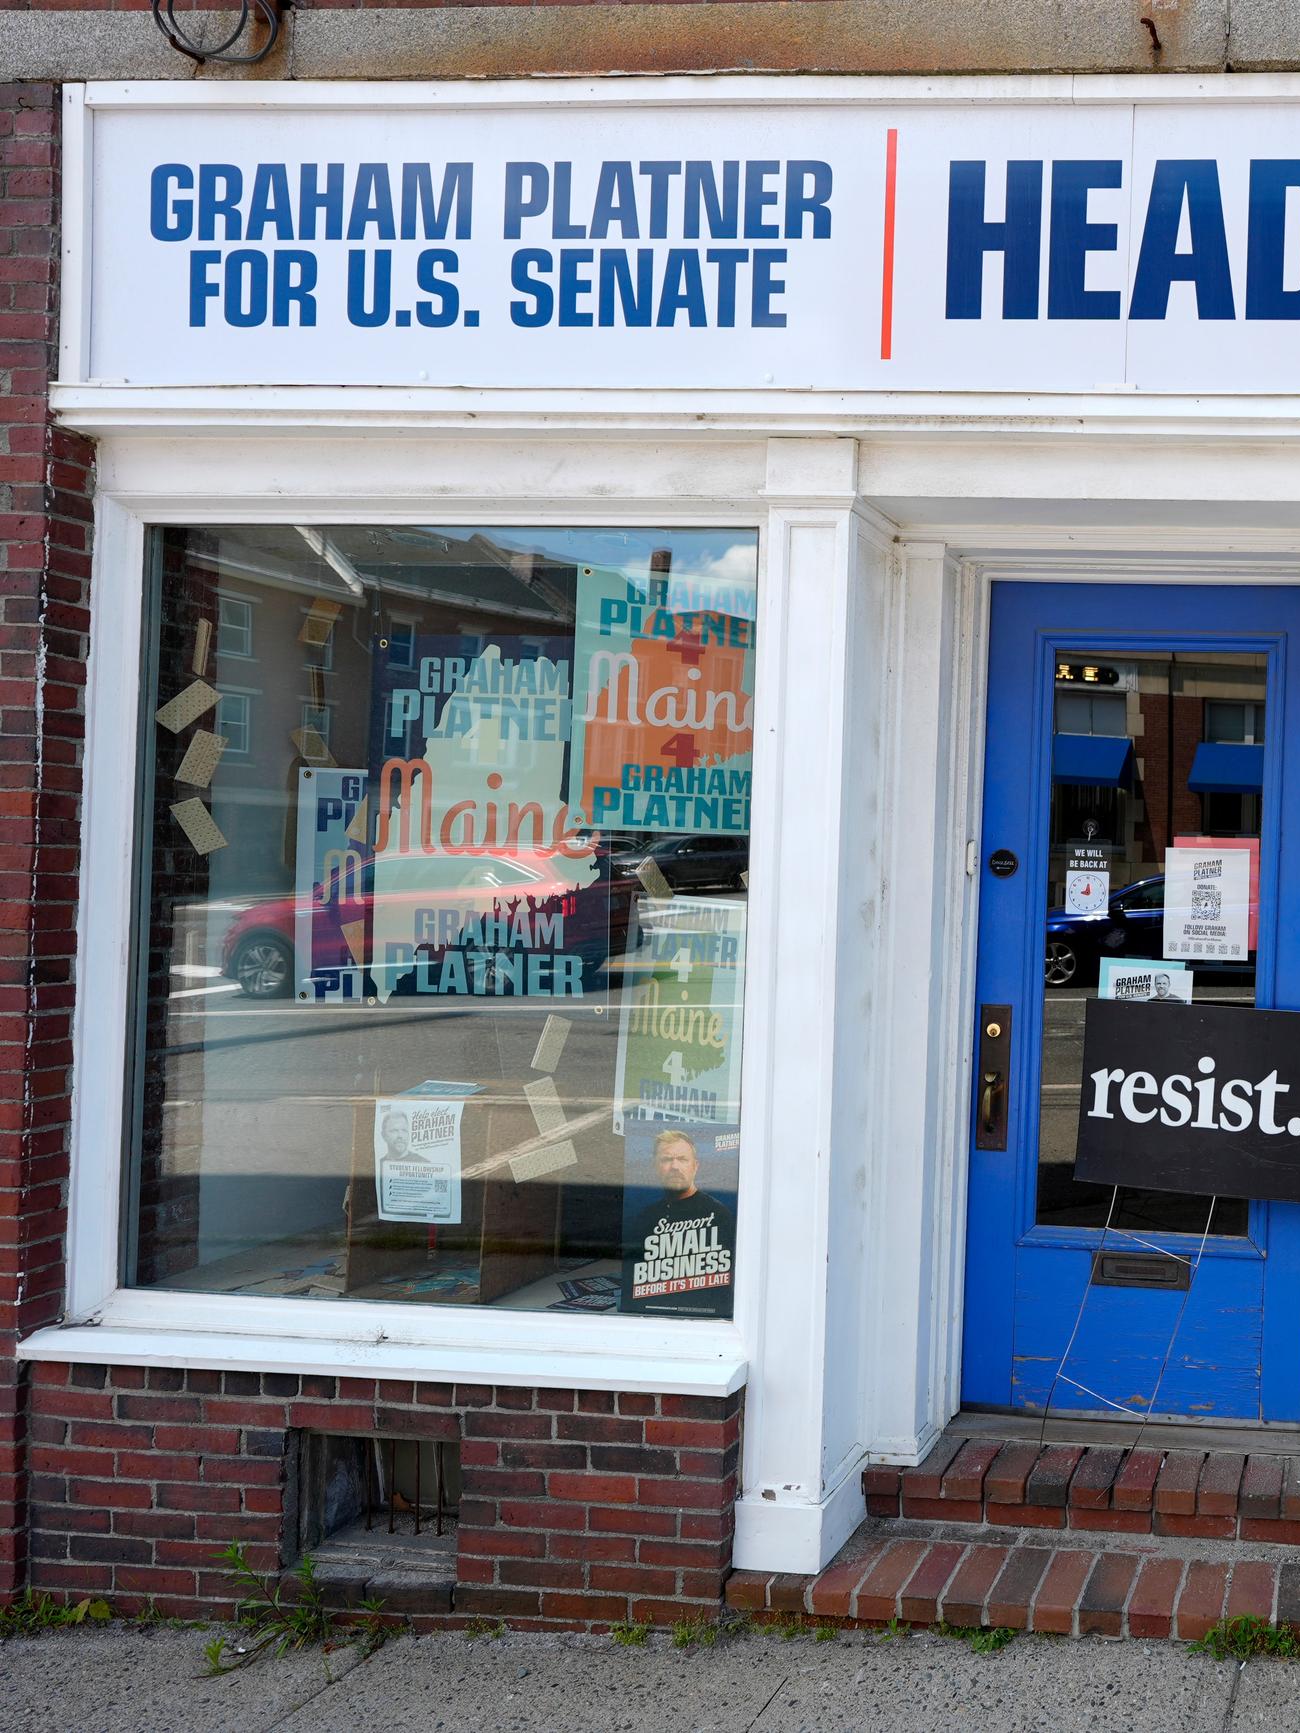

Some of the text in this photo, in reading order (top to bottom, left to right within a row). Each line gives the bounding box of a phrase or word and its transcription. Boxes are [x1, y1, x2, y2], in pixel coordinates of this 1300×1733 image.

[150, 160, 834, 242] GRAHAM PLATNER
[189, 248, 788, 329] FOR U.S. SENATE
[600, 597, 756, 650] PLATNE
[419, 656, 570, 696] GRAHAM
[660, 733, 701, 768] 4
[620, 763, 752, 795] GRAHAM
[373, 758, 600, 859] Maine
[593, 786, 750, 830] PLATNE
[1069, 860, 1079, 868] BE
[1080, 860, 1098, 868] BACK
[1074, 849, 1103, 857] WE WILL
[1193, 859, 1222, 870] GRAHAM
[1193, 866, 1222, 877] PLATNER
[413, 908, 565, 949] GRAHAM
[385, 942, 584, 998] PLATNER
[670, 947, 693, 983] 4
[1116, 974, 1152, 987] GRAHAM
[1115, 983, 1151, 995] PLATNER
[631, 977, 729, 1048] Maine
[662, 1051, 685, 1086] 4
[411, 1114, 456, 1131] GRAHAM
[411, 1126, 455, 1143] PLATNER
[653, 1212, 715, 1237] Support
[644, 1226, 722, 1261] SMALL
[634, 1249, 731, 1285] BUSINESS
[635, 1273, 729, 1297] BEFORE IT'S TOO LATE
